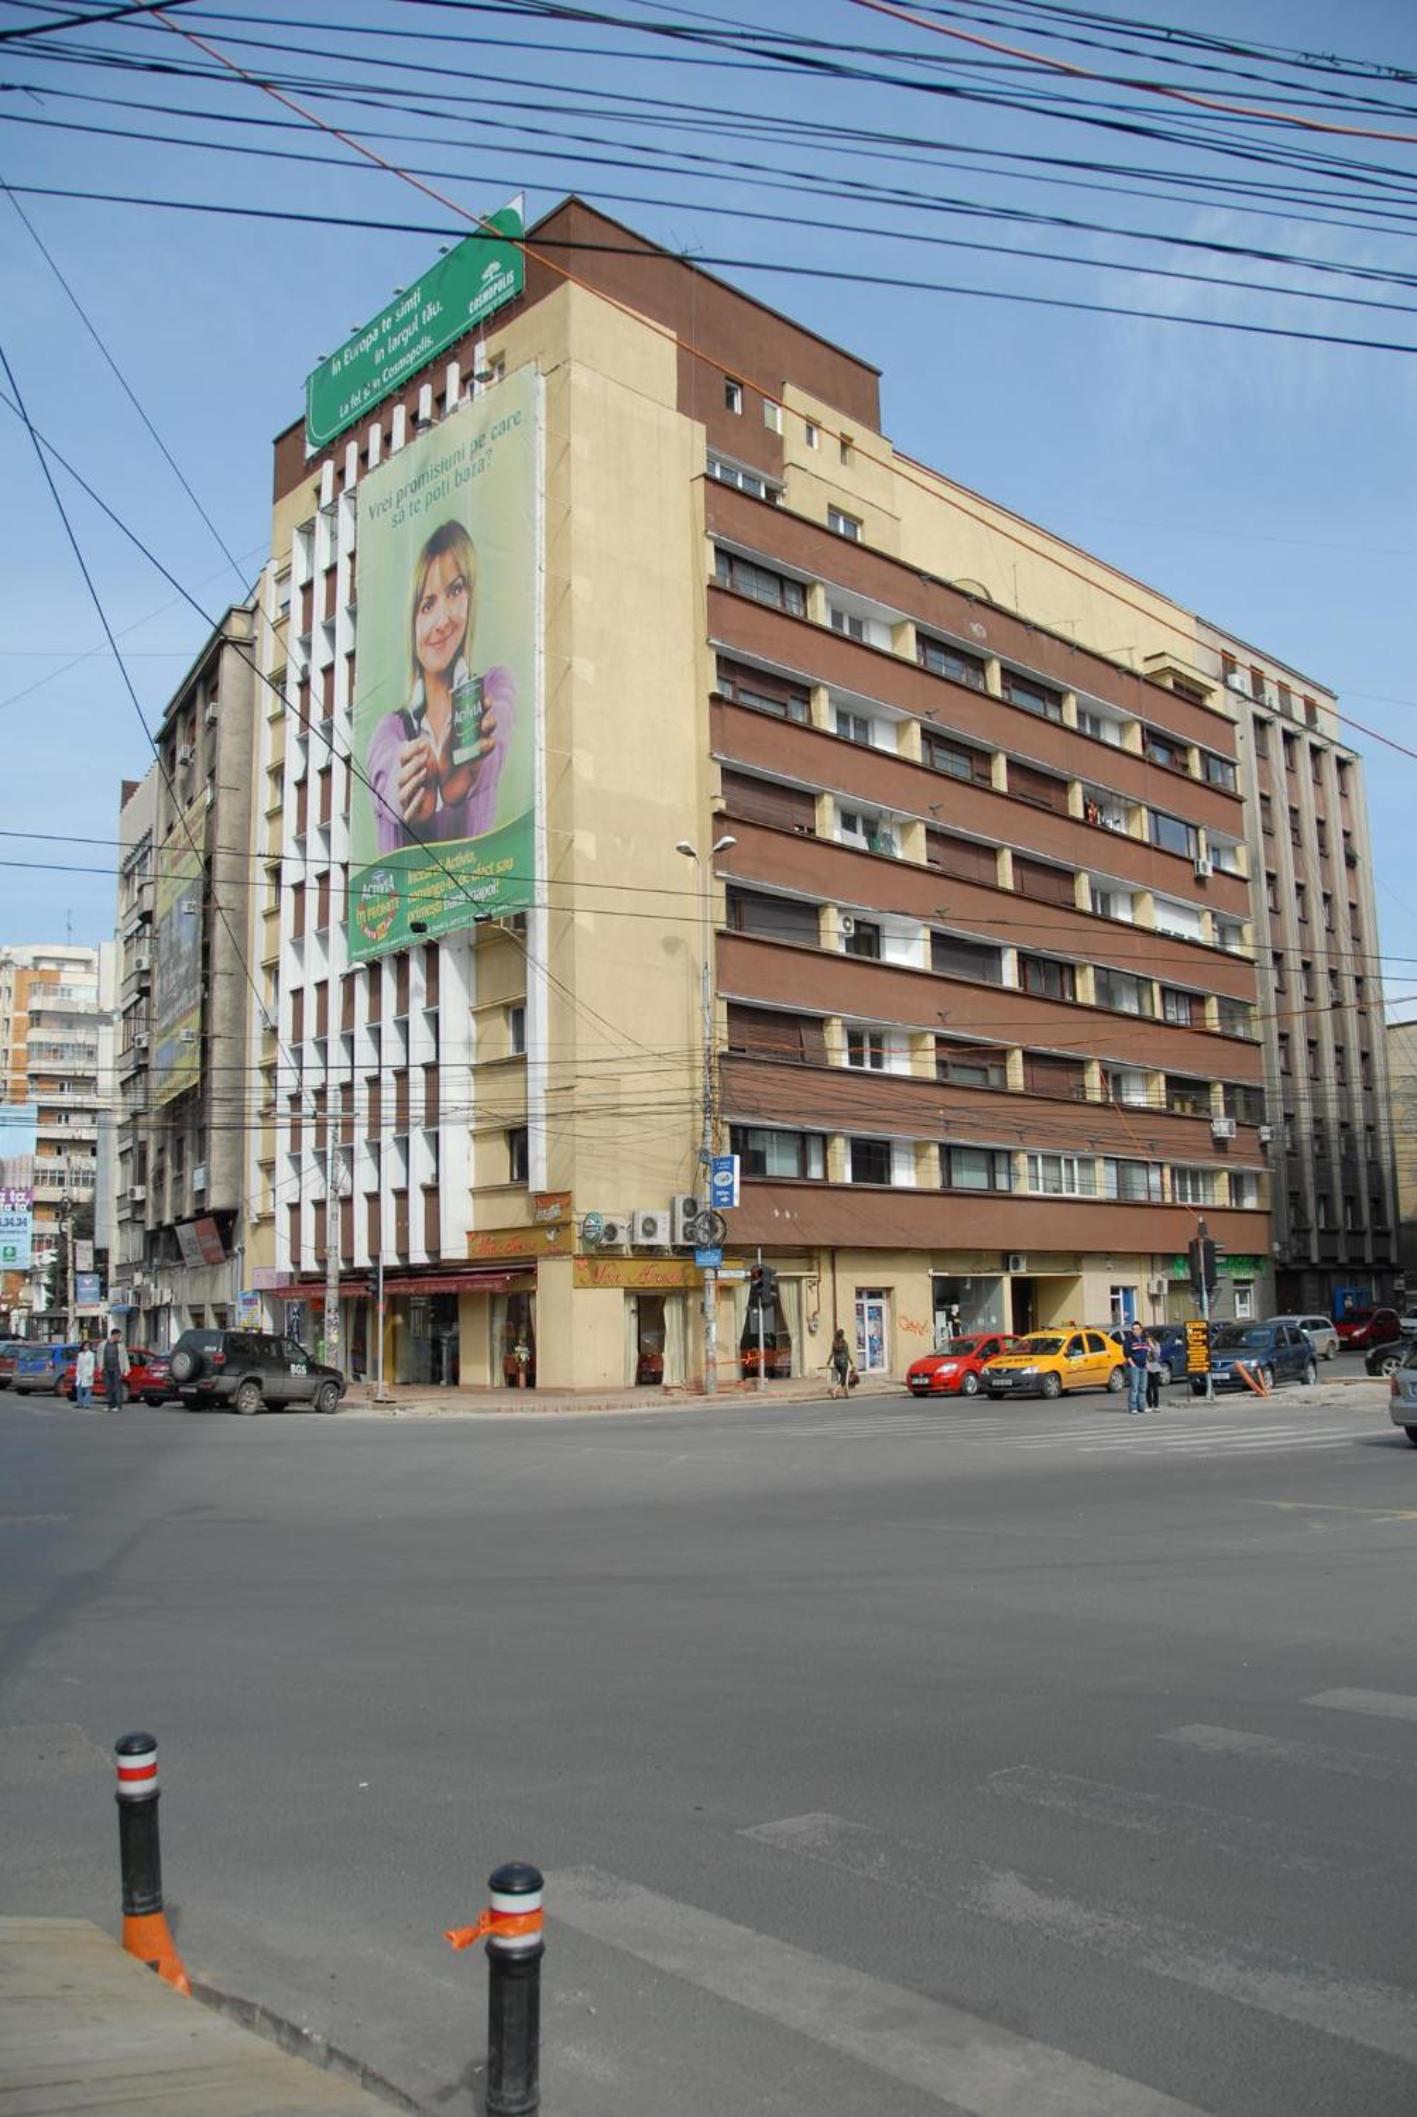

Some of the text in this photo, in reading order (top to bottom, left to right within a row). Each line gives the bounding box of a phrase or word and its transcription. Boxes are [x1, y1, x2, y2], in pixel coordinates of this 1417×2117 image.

[469, 270, 515, 315] COSMOPOLIS
[343, 327, 379, 366] Europa
[381, 316, 393, 333] te
[387, 313, 419, 353] largul
[368, 410, 523, 520] Vrei promisiuni pe care
[409, 498, 422, 517] te
